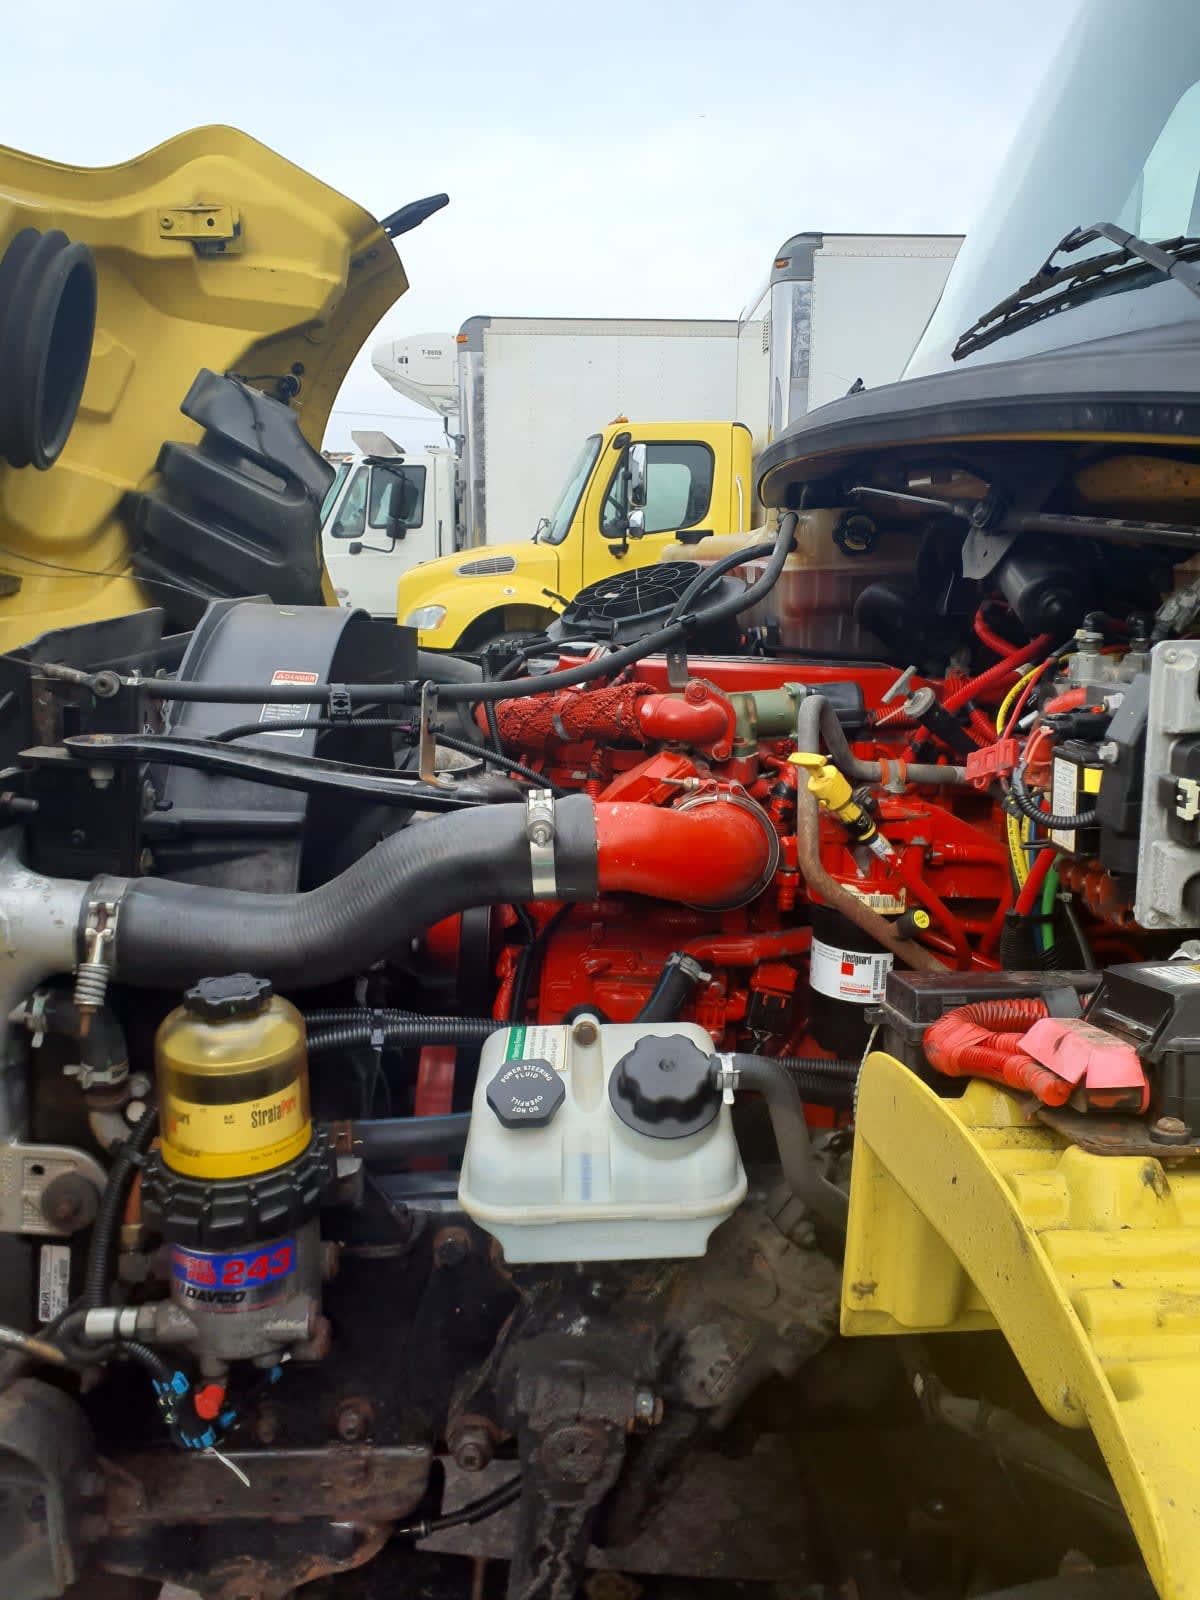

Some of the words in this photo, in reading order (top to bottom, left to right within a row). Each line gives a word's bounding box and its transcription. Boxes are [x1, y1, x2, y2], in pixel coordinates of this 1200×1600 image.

[284, 674, 316, 682] DANGER
[841, 951, 872, 966] Fleetguard
[500, 1066, 522, 1084] POWER
[523, 1064, 553, 1082] STEERING
[514, 1071, 540, 1080] FLUID
[511, 1095, 543, 1107] OVERFILL
[222, 1247, 292, 1286] 243
[185, 1286, 248, 1305] DAVCO
